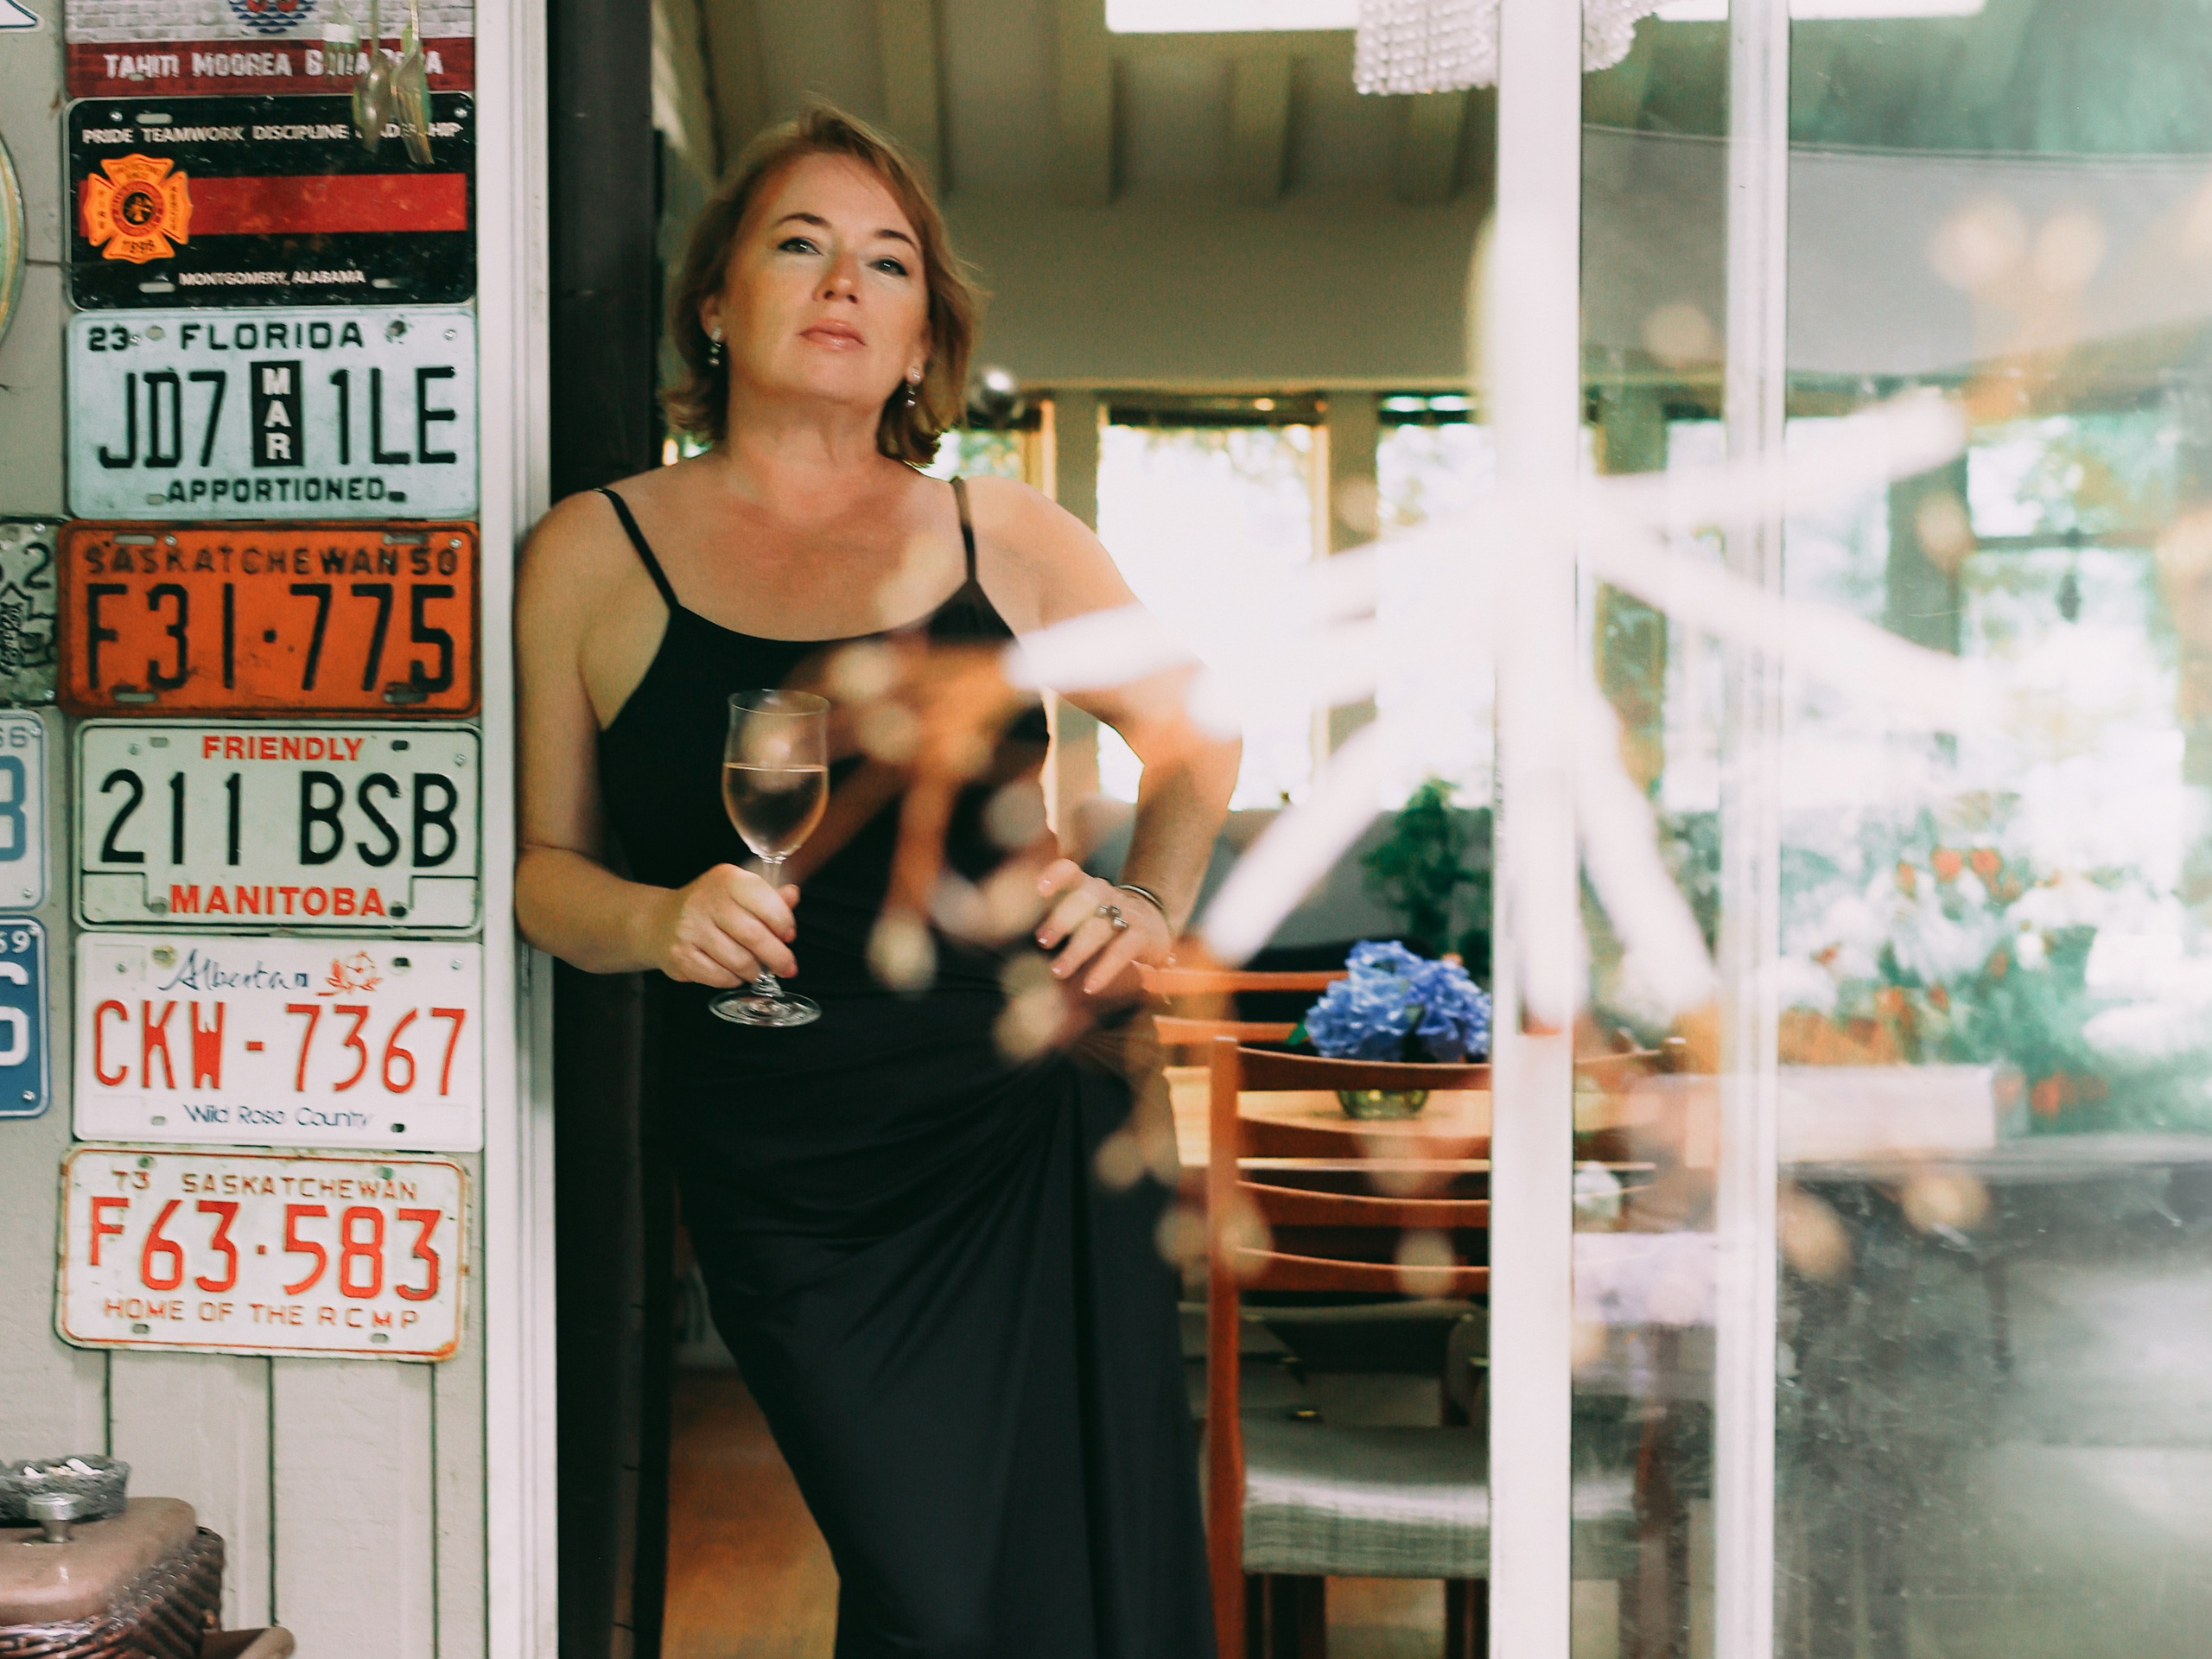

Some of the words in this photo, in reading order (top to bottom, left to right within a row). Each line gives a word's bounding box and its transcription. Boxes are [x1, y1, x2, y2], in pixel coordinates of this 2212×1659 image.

[103, 54, 180, 79] TAHITI
[192, 52, 293, 77] MOOREA
[82, 128, 134, 144] PRIDE
[140, 126, 245, 143] TEAMWORK
[252, 124, 350, 142] DISCIPLINE
[291, 270, 366, 284] ALABAMA
[87, 326, 130, 351] 23
[180, 321, 365, 350] FLORIDA
[98, 368, 228, 469] JD7
[329, 366, 458, 467] 1LE
[261, 367, 293, 461] MAR
[167, 477, 385, 504] APPORTIONED
[85, 546, 400, 576] SASKATCHEWAN
[410, 548, 459, 576] 50
[202, 735, 365, 761] FRIENDLY
[99, 768, 242, 866] 211
[299, 770, 459, 867] BSB
[169, 884, 387, 917] MANITOBA
[157, 948, 290, 991] Alberta
[94, 998, 467, 1096] CKW-7367
[182, 1103, 230, 1123] Wild
[238, 1104, 287, 1125] Rose
[181, 1172, 418, 1201] SASKATCHEWAN
[104, 1297, 185, 1321] HOME
[198, 1300, 234, 1323] OF
[249, 1302, 302, 1325] THE
